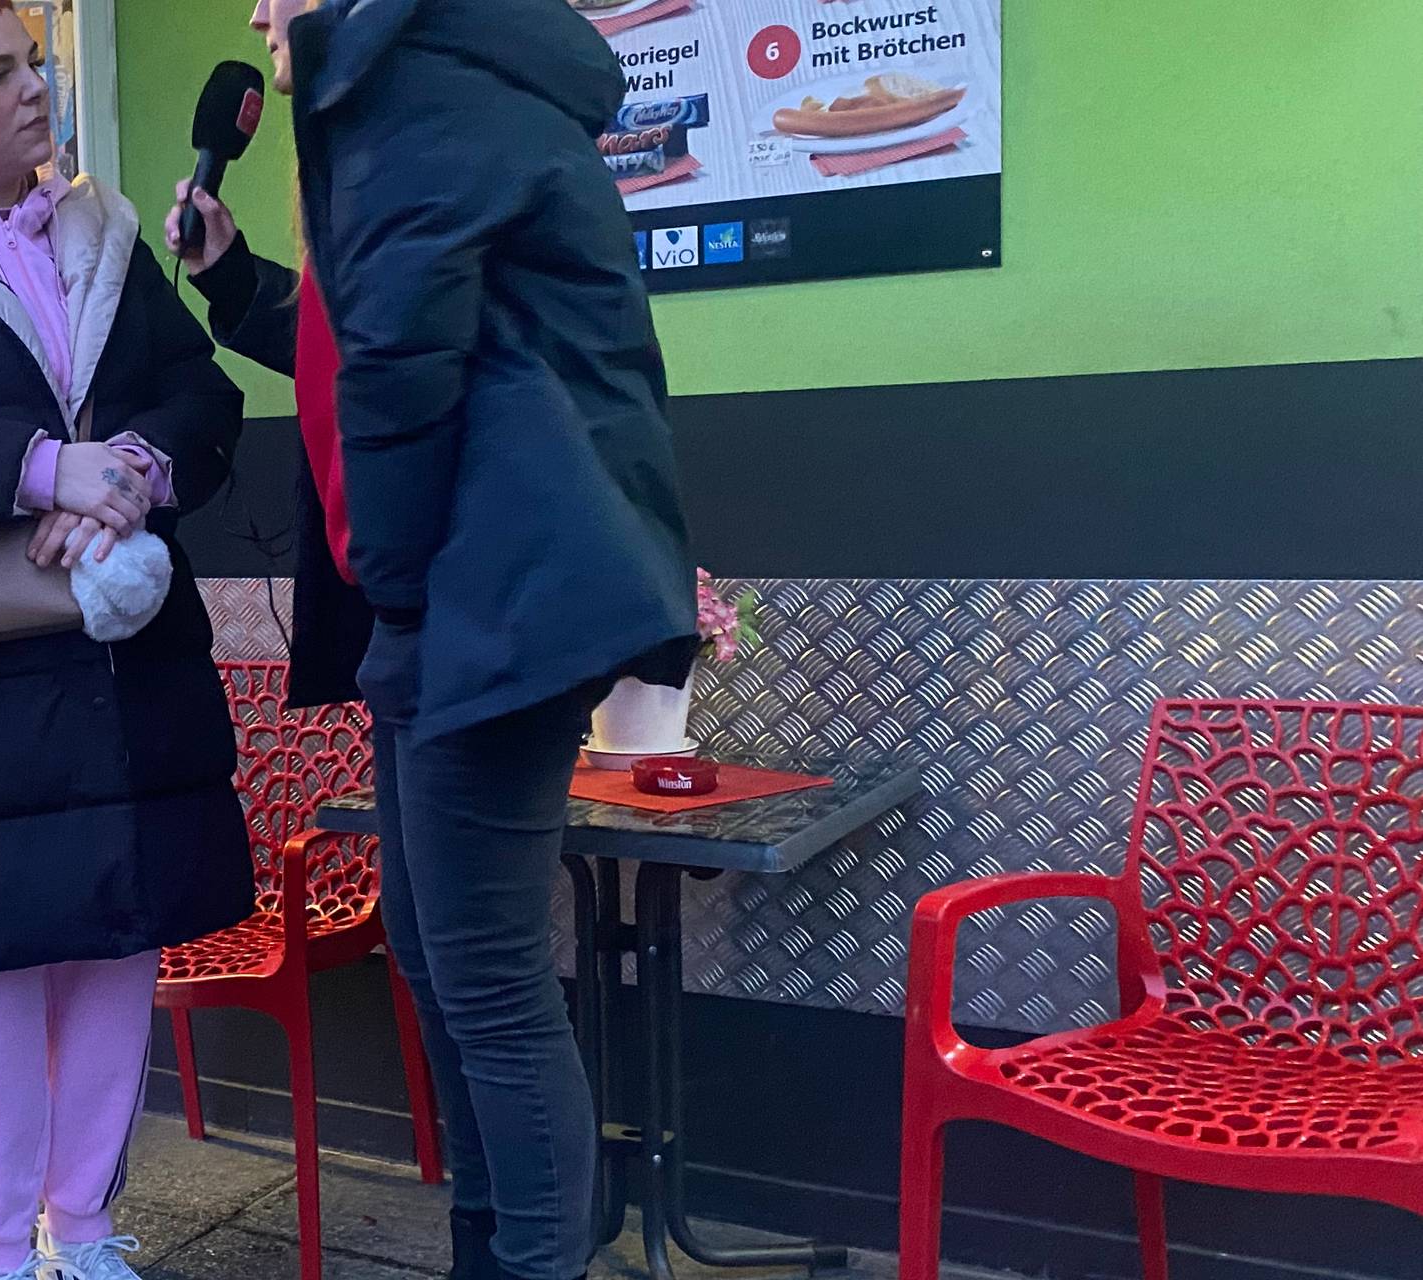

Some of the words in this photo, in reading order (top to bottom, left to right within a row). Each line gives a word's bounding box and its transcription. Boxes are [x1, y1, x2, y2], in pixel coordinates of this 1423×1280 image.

[812, 5, 938, 40] Bockwurst
[615, 40, 699, 68] koriegel
[765, 41, 780, 61] 6
[812, 47, 850, 68] mit
[857, 32, 967, 62] Brötchen
[625, 70, 674, 93] Wahl
[708, 240, 739, 251] NESTEA
[655, 248, 696, 267] ViO
[658, 777, 692, 789] Winston
